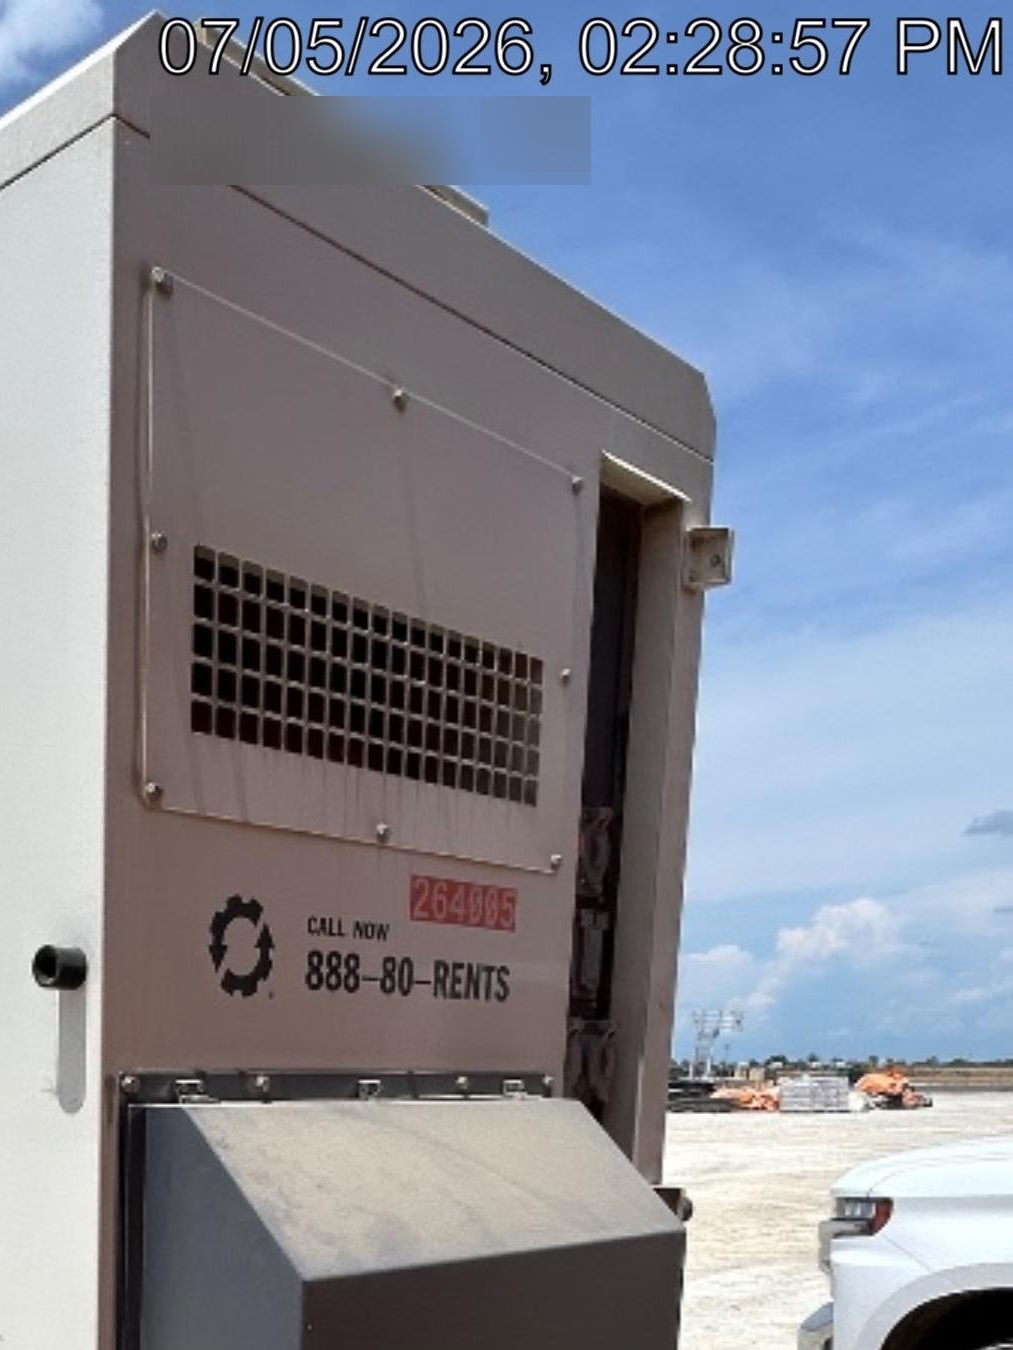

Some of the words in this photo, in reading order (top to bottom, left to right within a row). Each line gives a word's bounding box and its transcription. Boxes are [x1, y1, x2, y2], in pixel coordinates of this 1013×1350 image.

[308, 915, 345, 937] CALL
[353, 920, 390, 942] NOW
[305, 949, 511, 1003] 888-80-RENTS
